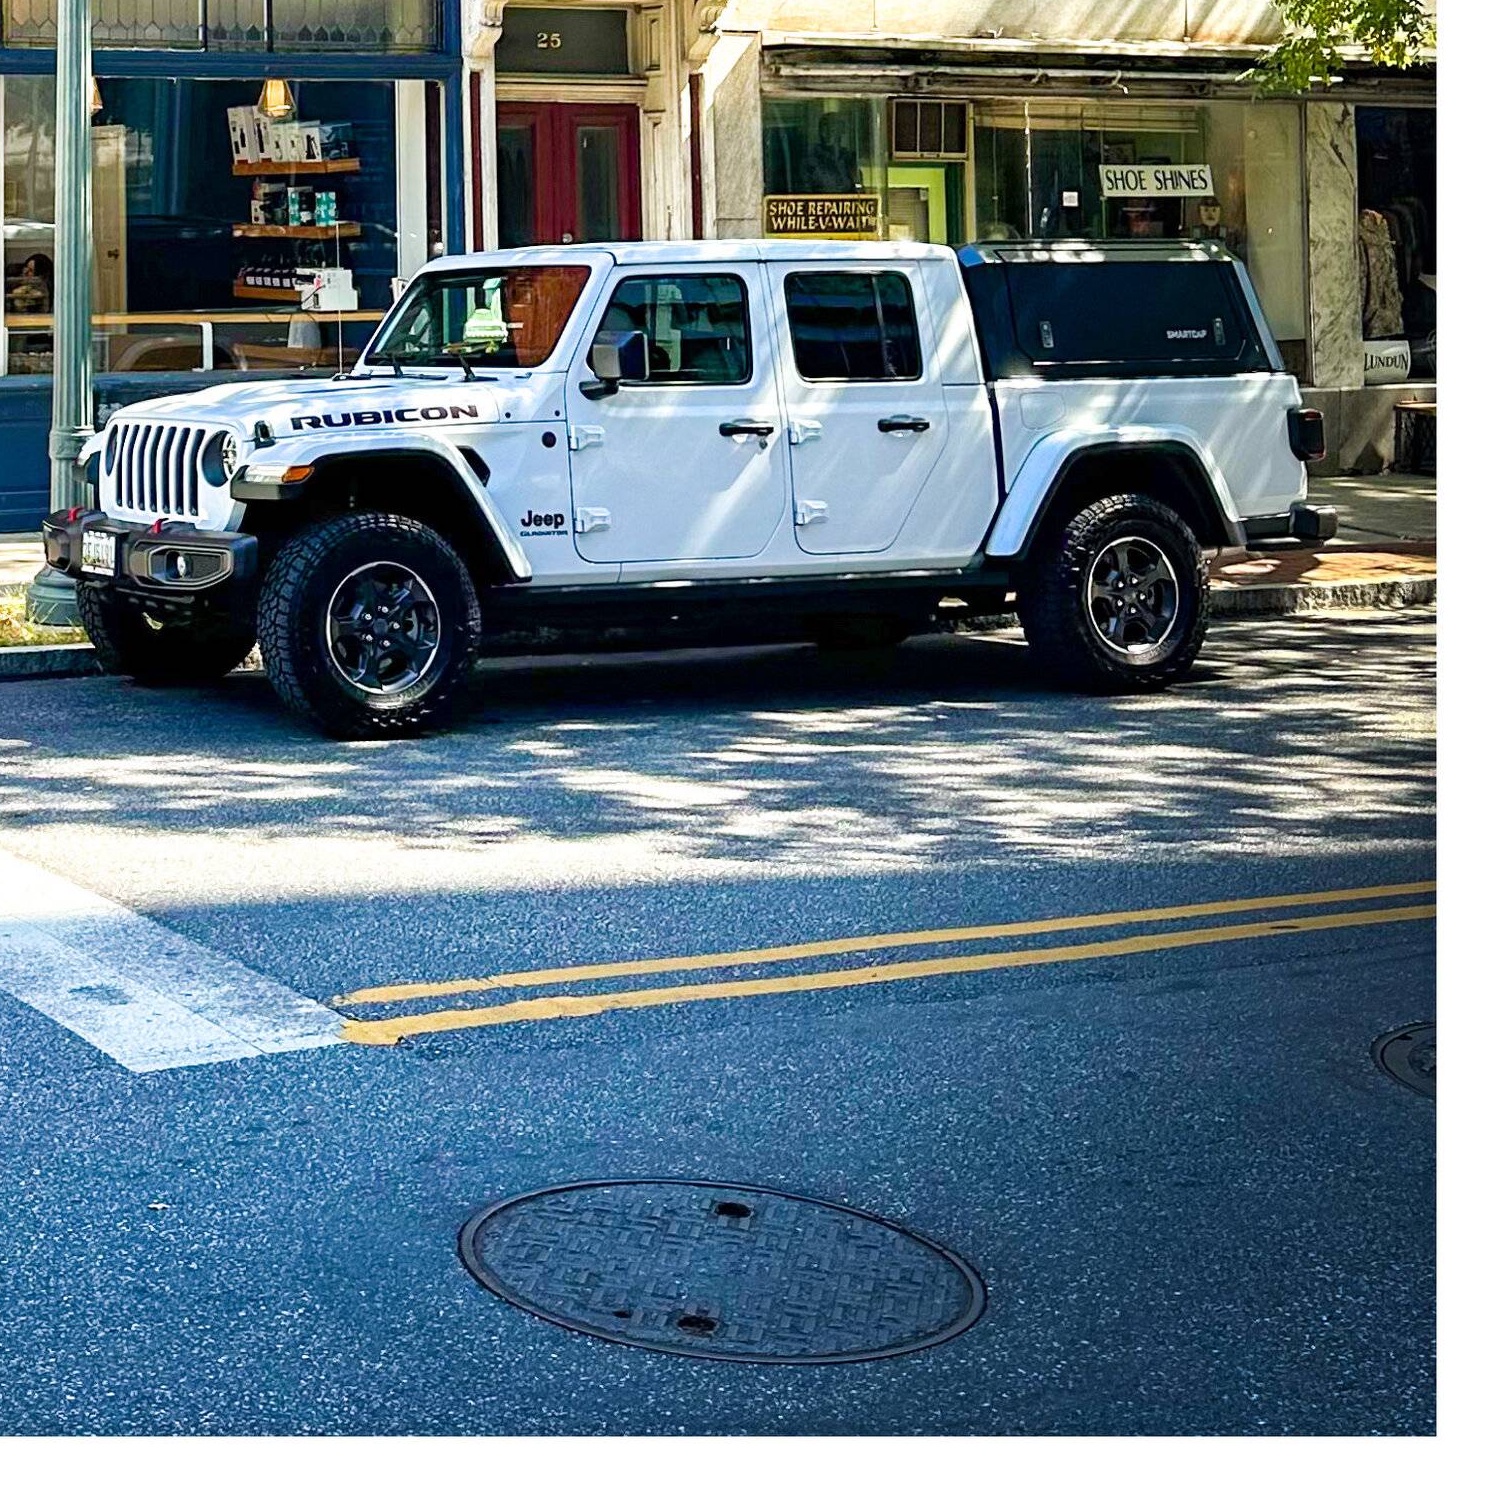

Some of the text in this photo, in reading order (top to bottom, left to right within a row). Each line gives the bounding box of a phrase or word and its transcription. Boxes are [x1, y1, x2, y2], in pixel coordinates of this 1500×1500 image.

[537, 33, 562, 48] 25
[1105, 169, 1208, 190] SHOE SHINES
[769, 201, 874, 216] SHOE REPAIRING
[290, 405, 479, 430] RUBICON
[521, 510, 564, 529] Jeep
